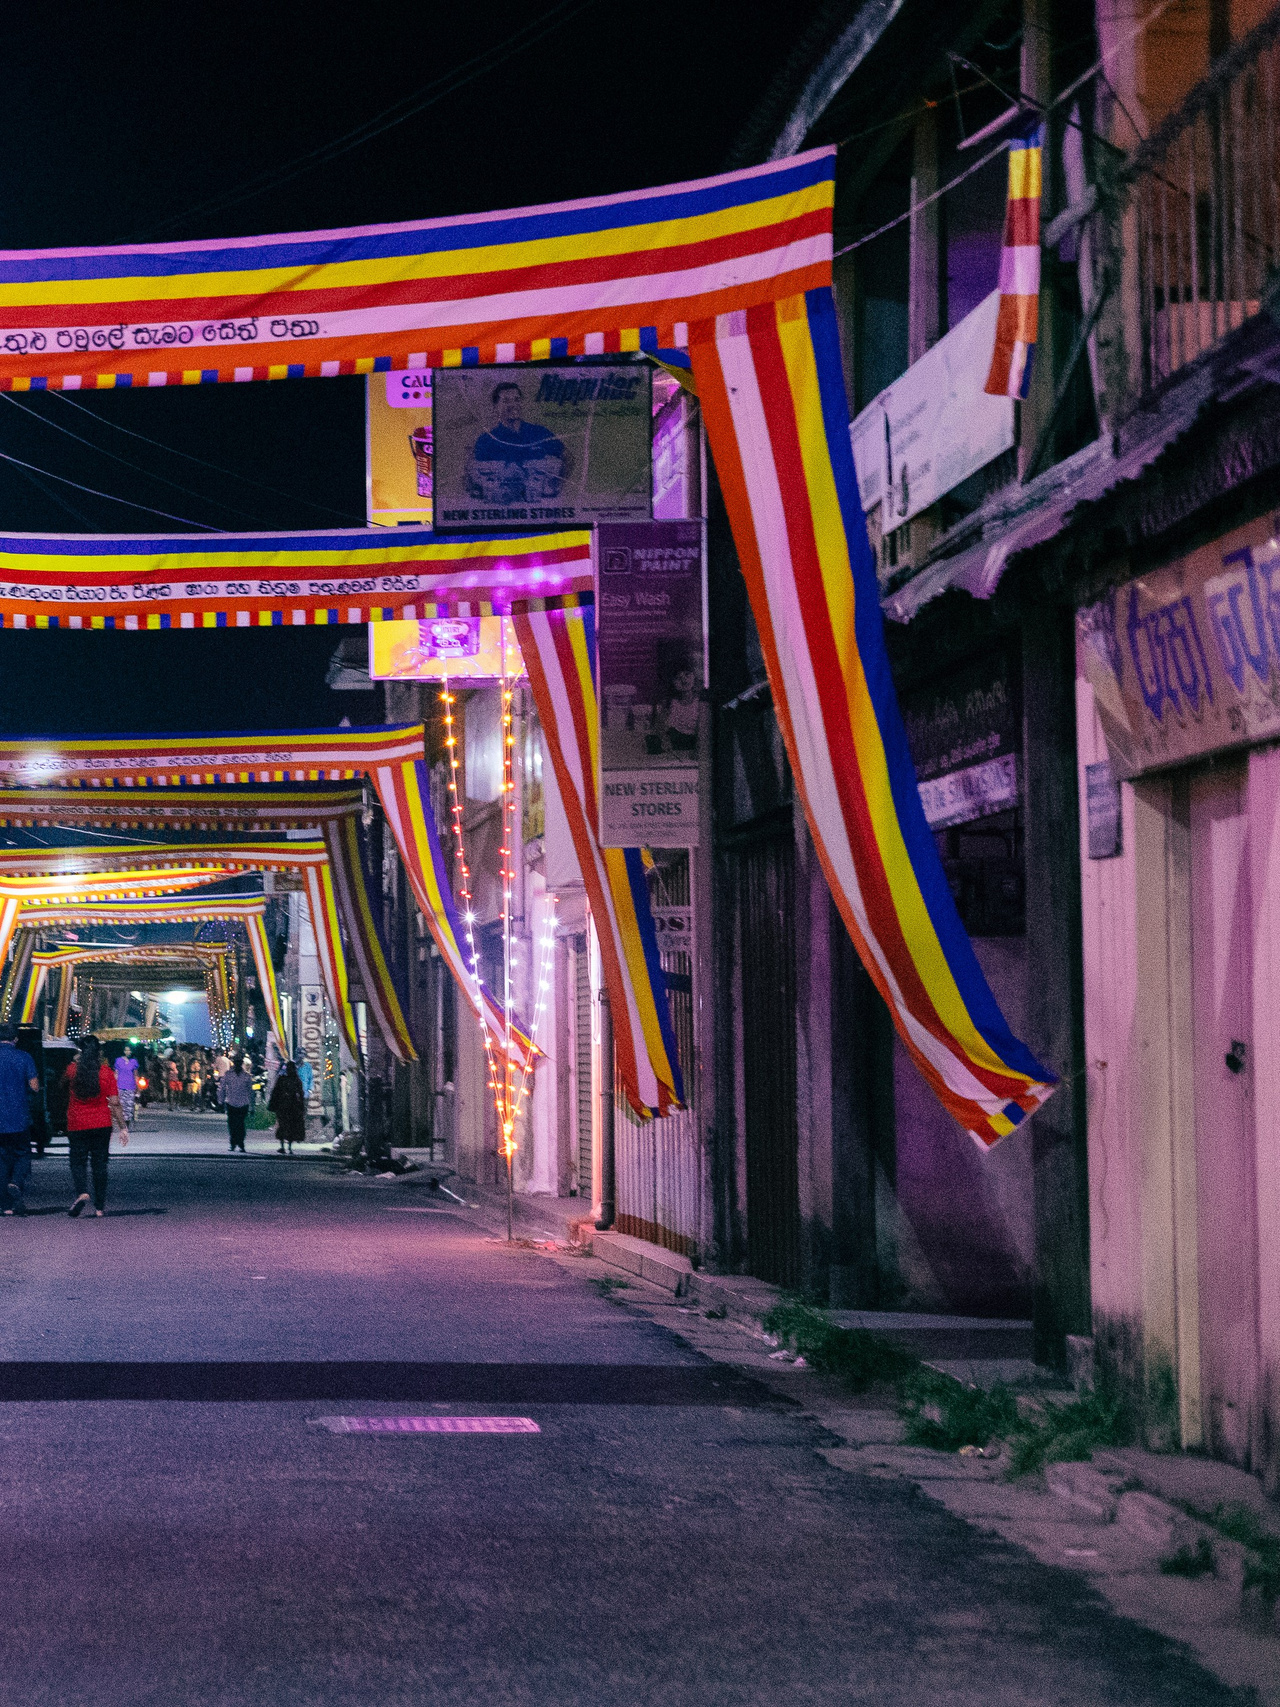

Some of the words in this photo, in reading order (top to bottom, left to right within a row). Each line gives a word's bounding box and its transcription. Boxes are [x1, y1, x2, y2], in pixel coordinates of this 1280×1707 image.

[443, 509, 470, 521] NEW
[472, 508, 527, 520] STERLING
[531, 507, 575, 520] STORES
[633, 547, 699, 560] NIPPON
[640, 559, 692, 571] PAINT
[635, 591, 671, 606] Wash
[605, 784, 635, 796] NEW
[632, 803, 682, 816] STORES
